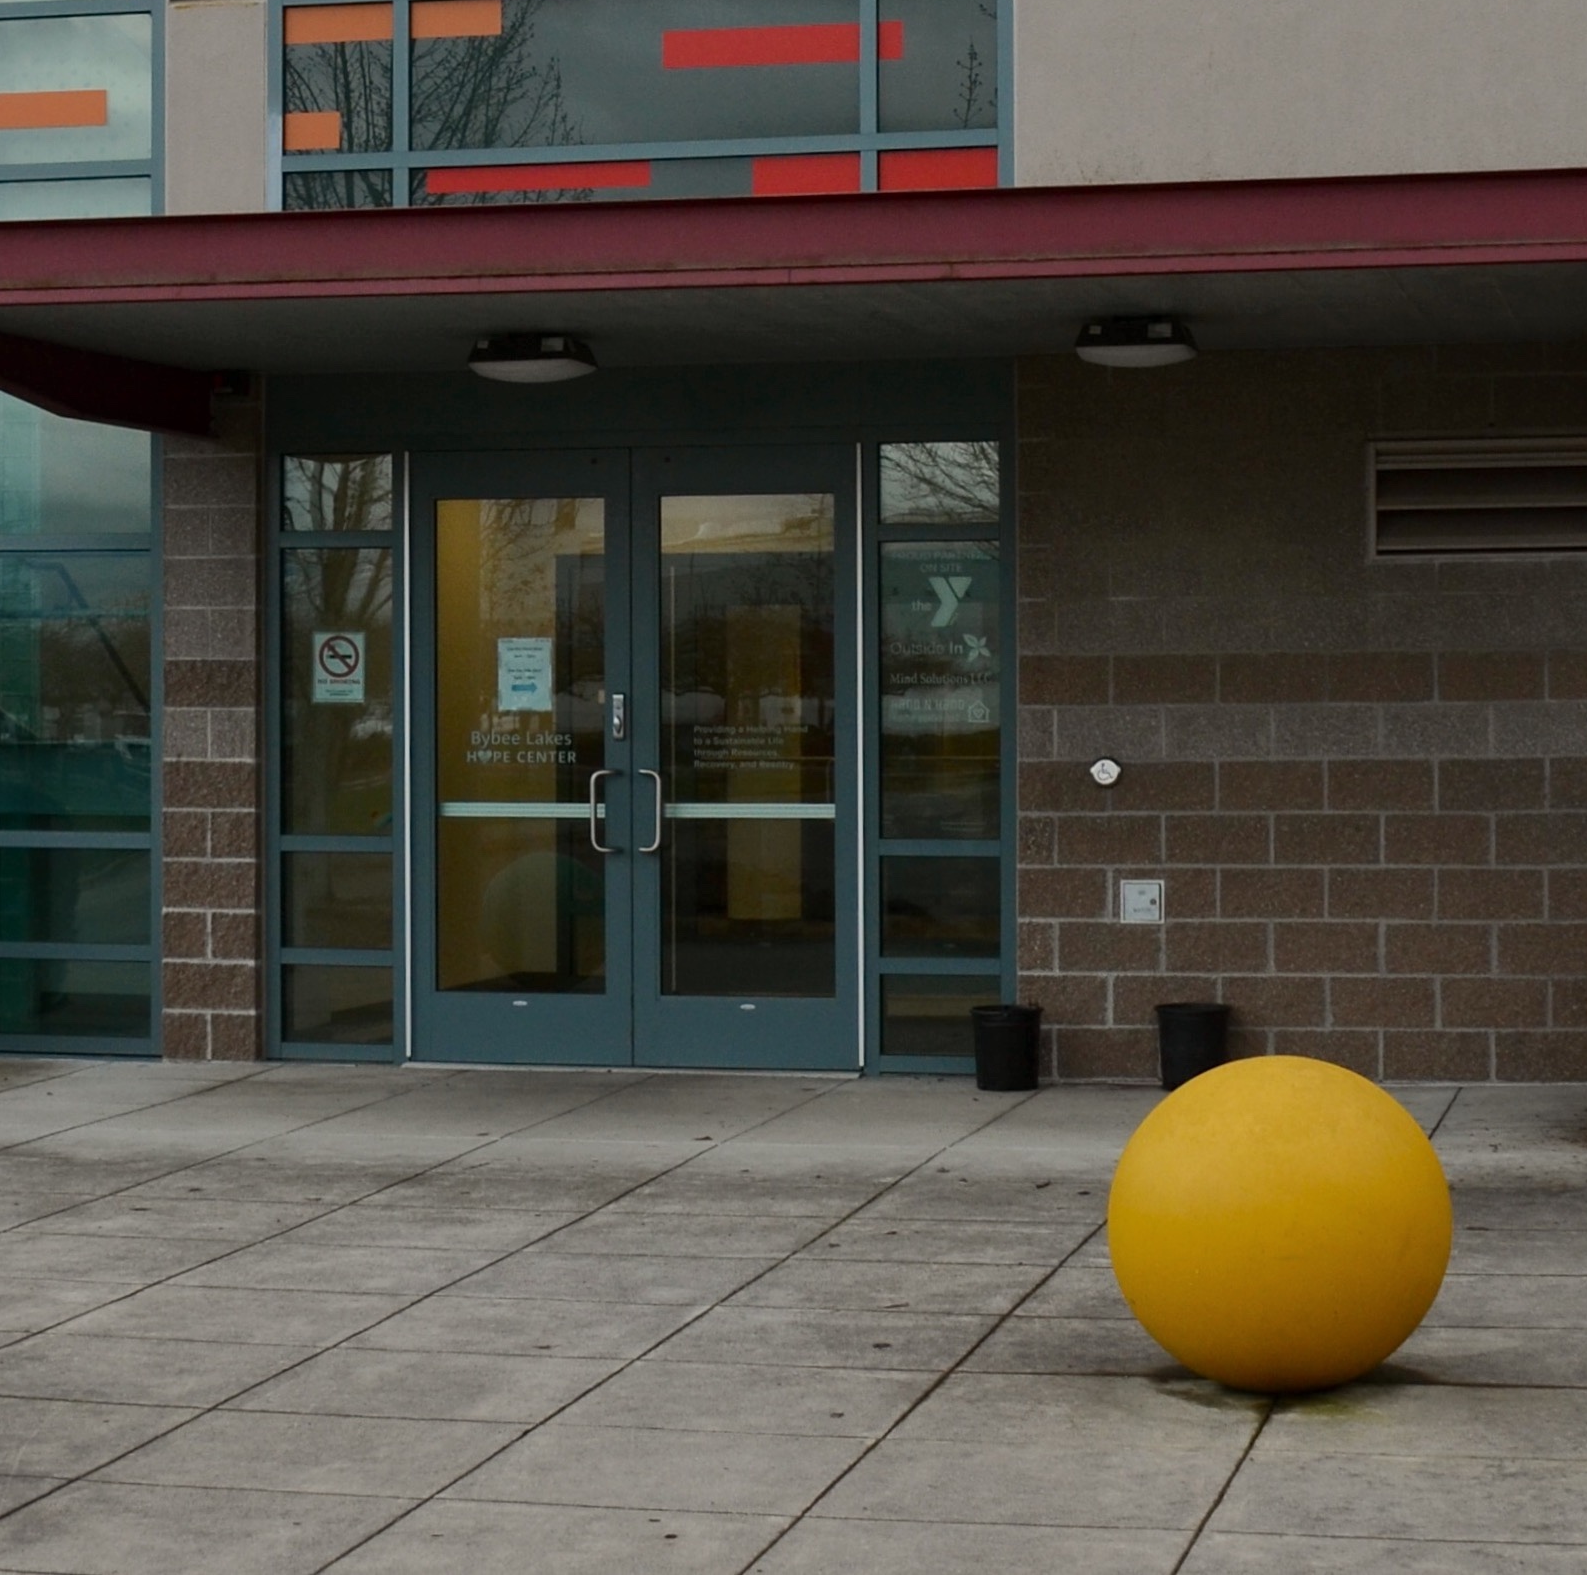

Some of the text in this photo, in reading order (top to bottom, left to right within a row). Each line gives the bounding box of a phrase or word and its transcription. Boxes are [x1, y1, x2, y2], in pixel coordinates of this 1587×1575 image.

[911, 599, 933, 612] the
[890, 641, 964, 656] Outside In
[890, 673, 918, 684] Mind
[920, 673, 968, 684] Solutions
[694, 725, 736, 735] Providing
[470, 730, 573, 749] Bybee Lakes
[694, 737, 703, 745] to
[713, 737, 765, 745] Sustainable
[516, 750, 578, 763] CENTER
[694, 749, 729, 758] through
